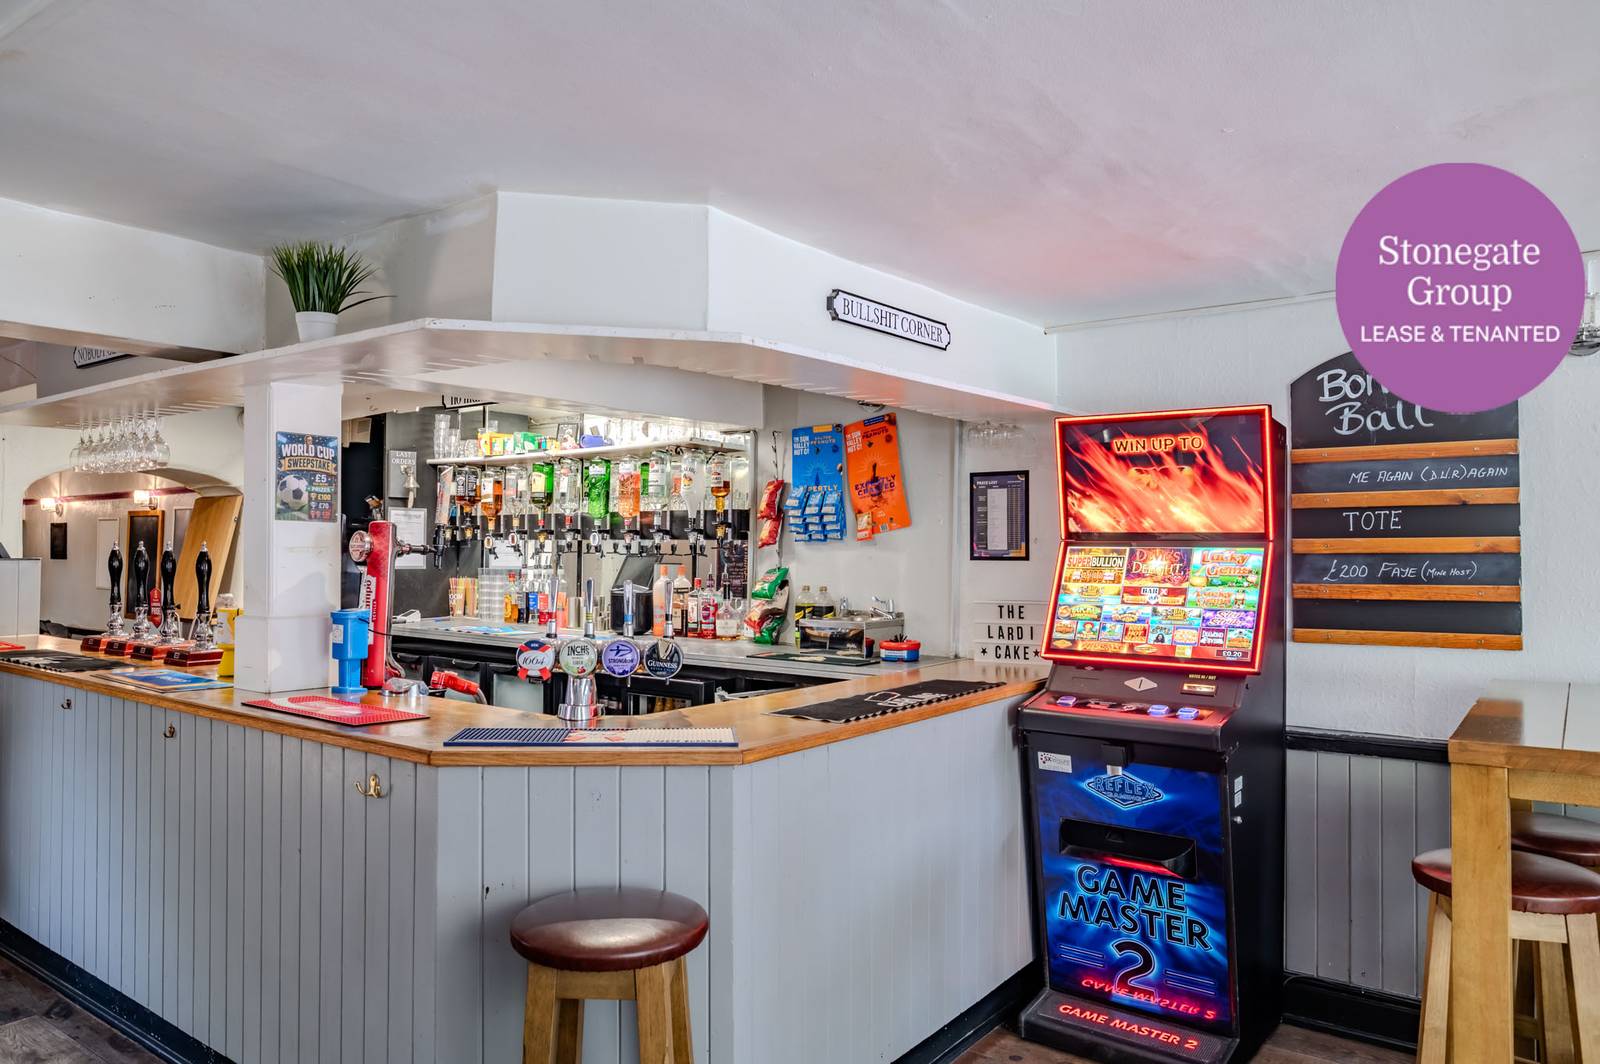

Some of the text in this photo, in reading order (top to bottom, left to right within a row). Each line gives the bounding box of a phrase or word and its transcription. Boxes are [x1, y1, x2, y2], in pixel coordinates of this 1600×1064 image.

[842, 297, 944, 344] BULLSHIT CORNER
[1325, 400, 1434, 436] Ball
[281, 443, 335, 461] WORLD CUP
[1114, 435, 1204, 453] WIN UP TO
[287, 458, 330, 472] SWEEPSTAKE
[391, 457, 416, 465] ORDERS
[315, 474, 327, 483] £5
[1349, 471, 1369, 484] ME
[1376, 471, 1414, 482] AGAIN
[1342, 509, 1402, 532] TOTE
[1201, 550, 1249, 566] Lucky
[1323, 559, 1368, 582] £200
[997, 604, 1025, 620] THE
[987, 625, 1024, 640] LARD
[521, 656, 545, 666] 1664
[995, 645, 1030, 660] CAKE
[1222, 650, 1242, 658] £0.20
[647, 659, 678, 669] GUINNESS
[1093, 776, 1157, 799] REFLEX
[1076, 863, 1187, 914] GAME
[1058, 891, 1213, 951] MASTER
[1111, 938, 1159, 1003] 2
[1058, 1004, 1199, 1051] GAME MASTER 2
